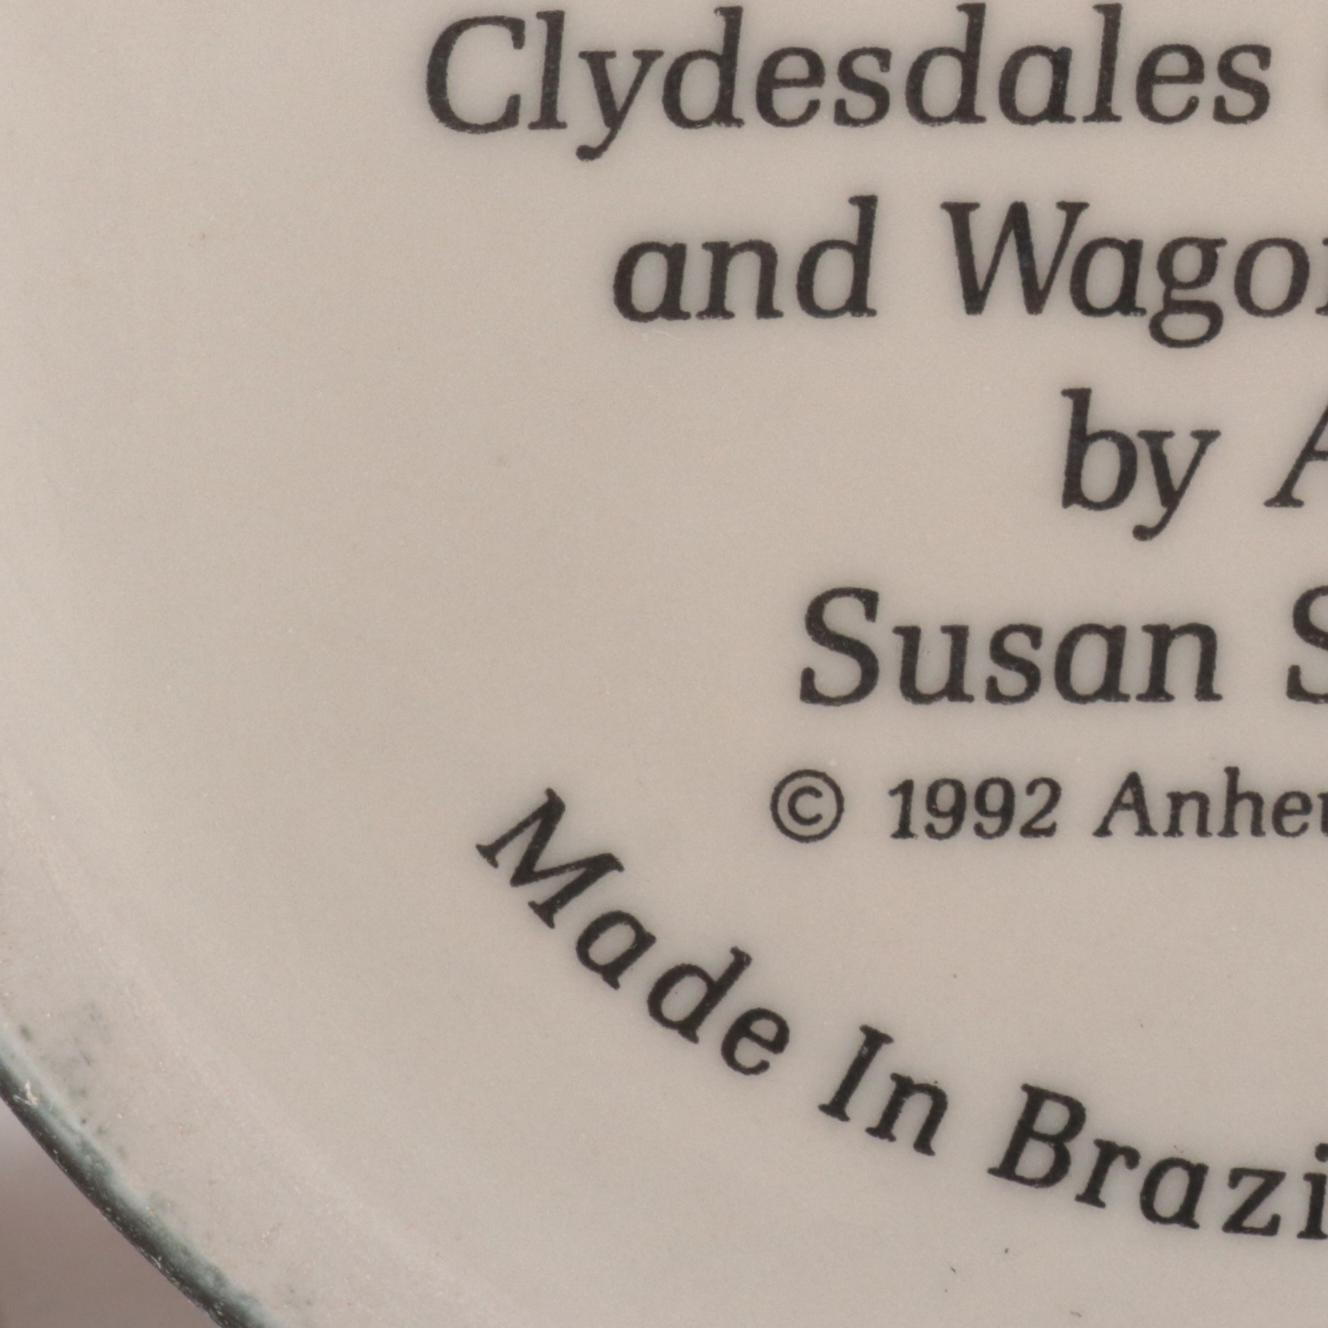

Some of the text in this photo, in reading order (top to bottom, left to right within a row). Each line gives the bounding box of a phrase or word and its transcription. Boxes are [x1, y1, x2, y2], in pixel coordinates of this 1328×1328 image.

[424, 0, 1273, 163] Clydesdales
[610, 192, 880, 325] and
[1059, 385, 1223, 543] by
[798, 585, 1225, 709] Susan
[886, 775, 1064, 843] 1992
[474, 786, 792, 1078] Made
[816, 1022, 950, 1158] In
